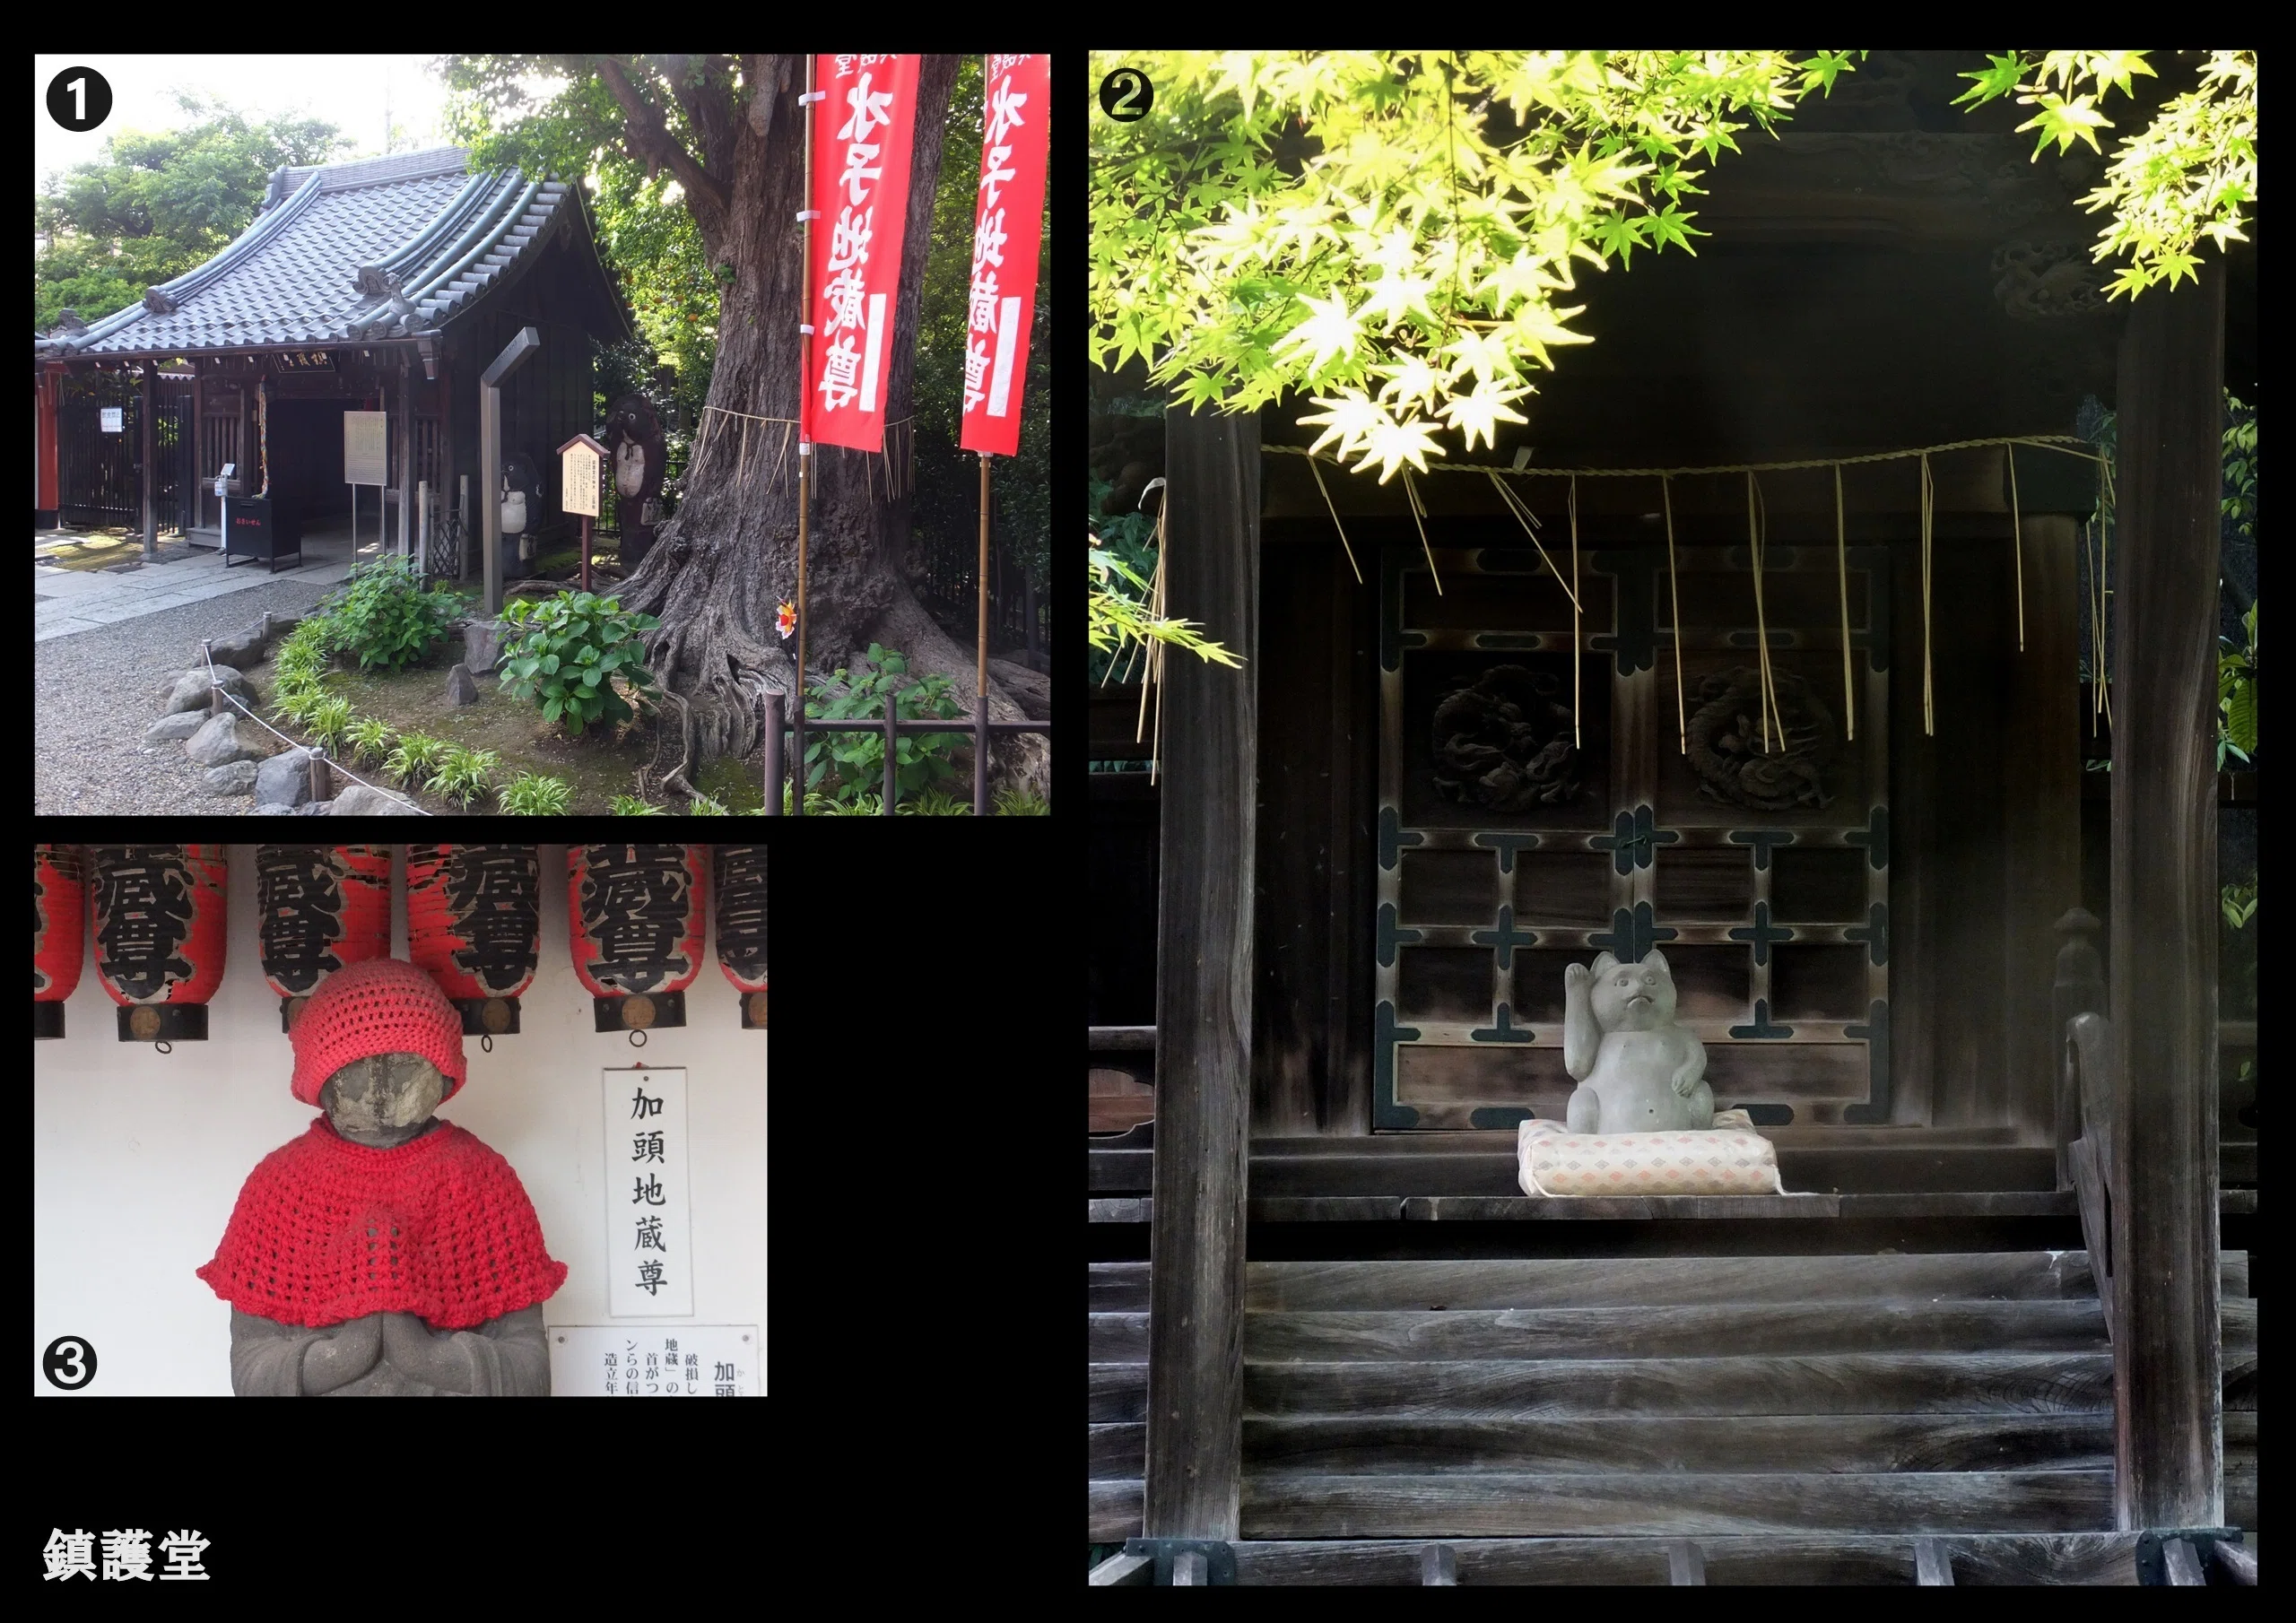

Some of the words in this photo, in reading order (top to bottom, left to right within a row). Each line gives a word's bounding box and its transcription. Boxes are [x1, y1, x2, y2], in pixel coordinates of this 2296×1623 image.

[630, 1087, 668, 1297] 加頭地蔵尊
[604, 1352, 619, 1396] 造立年
[625, 1339, 639, 1396] ンらの信
[645, 1352, 659, 1396] 首がつ
[665, 1338, 679, 1396] 地蔵」の
[684, 1353, 699, 1395] 破損し
